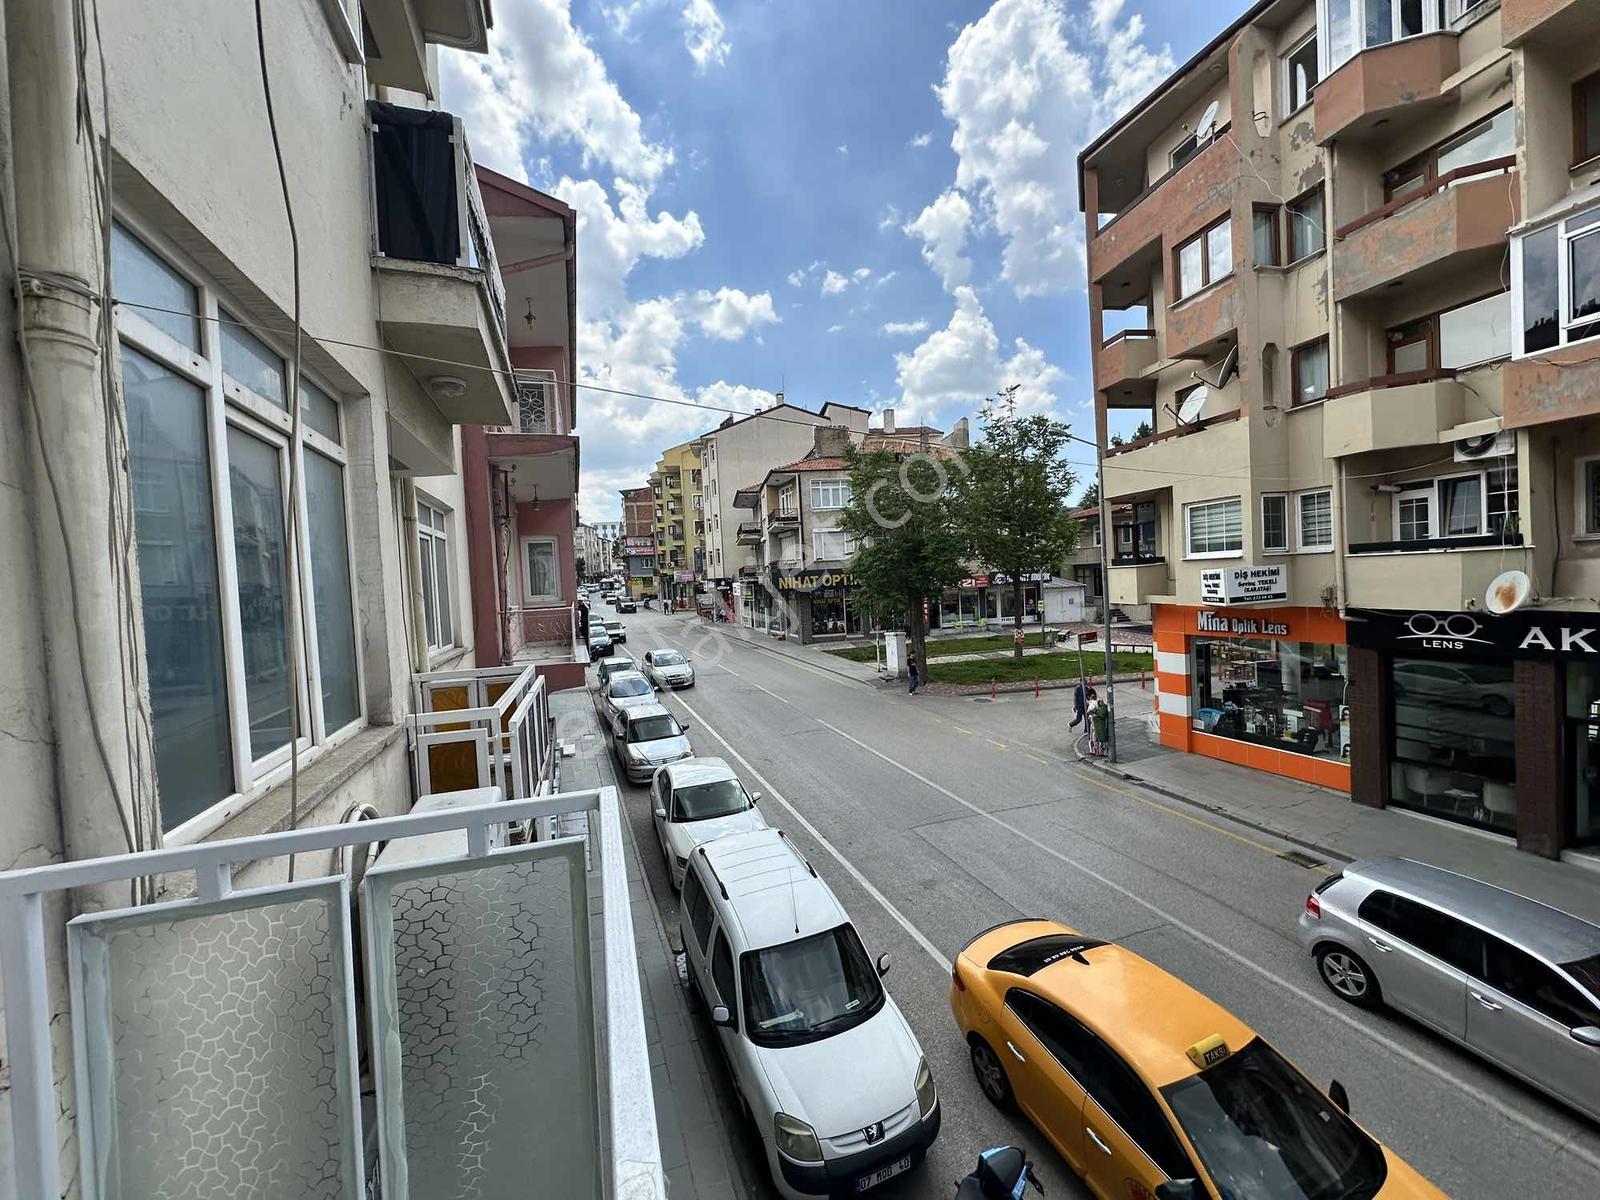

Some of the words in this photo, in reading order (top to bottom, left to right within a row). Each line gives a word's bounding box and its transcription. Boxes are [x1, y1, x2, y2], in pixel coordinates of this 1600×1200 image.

[1234, 569, 1248, 580] DİŞ
[1250, 566, 1280, 577] HEKİMİ
[1197, 611, 1229, 632] Mina
[1232, 618, 1257, 635] Optik
[1262, 619, 1288, 635] Lens
[1422, 639, 1464, 650] LENS
[1518, 626, 1598, 653] AK
[860, 1177, 871, 1190] 07
